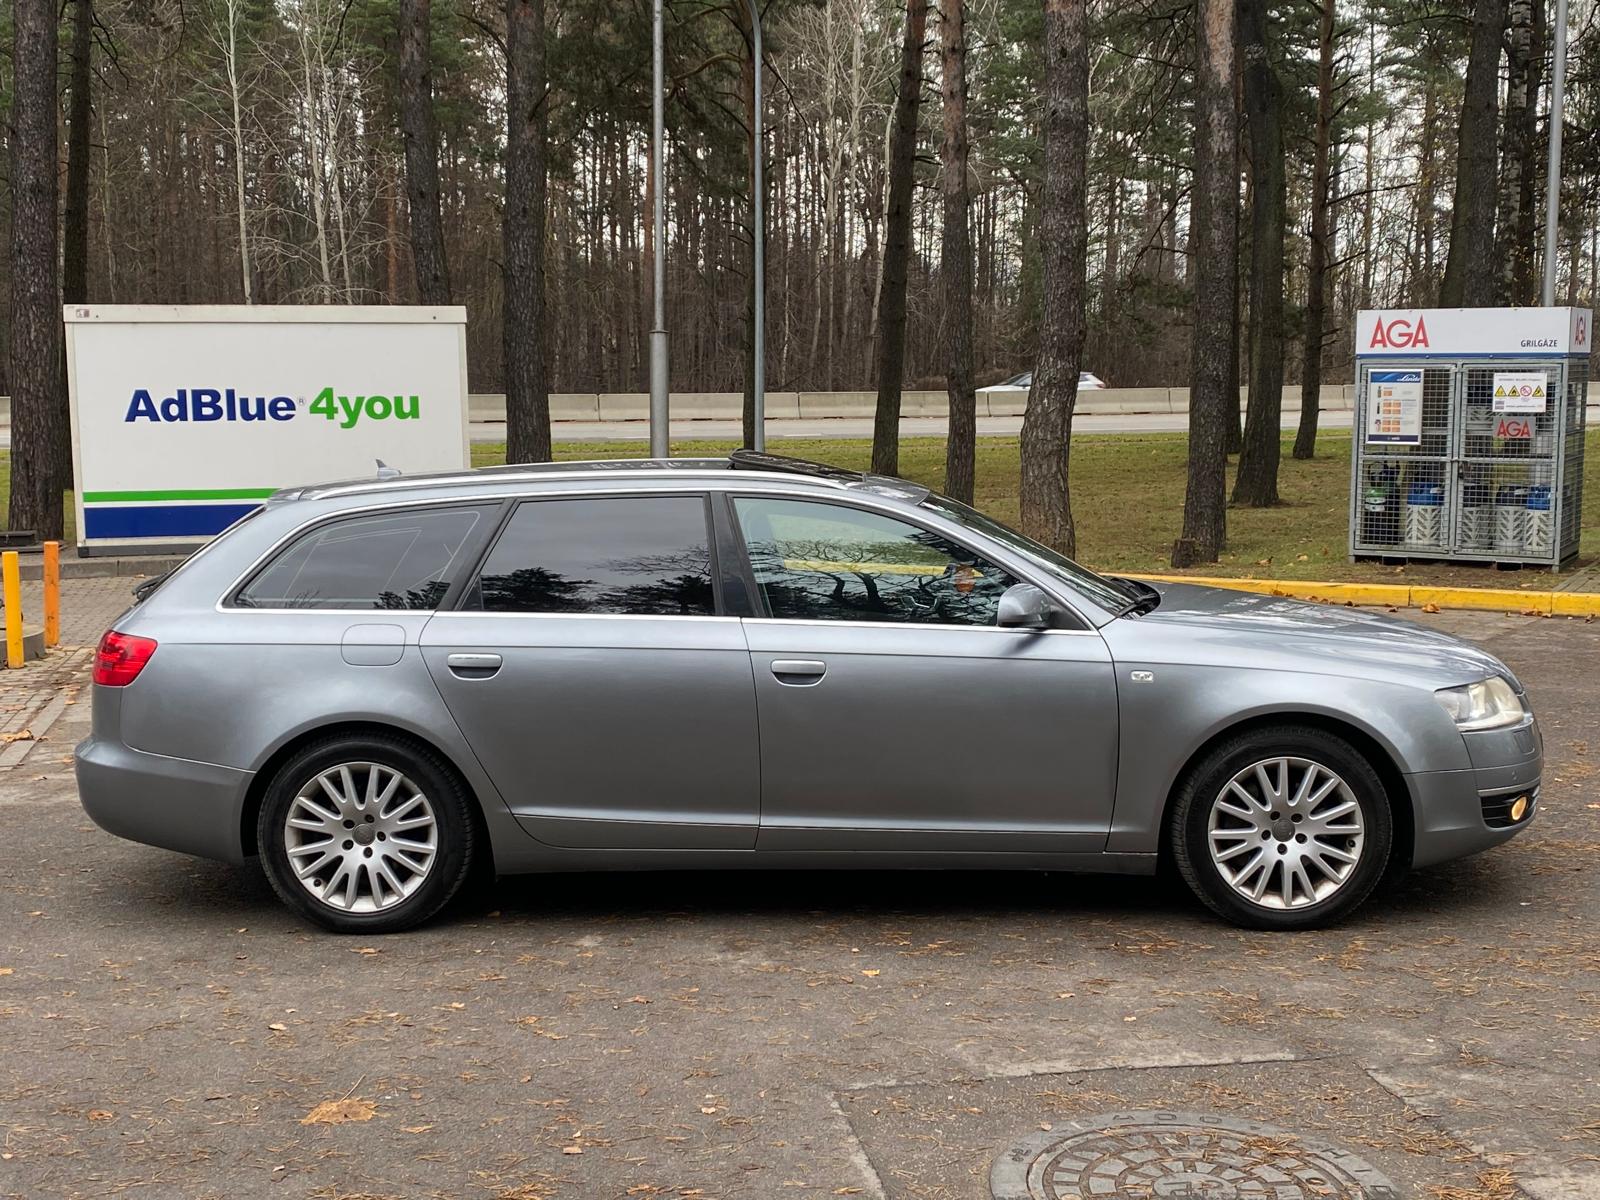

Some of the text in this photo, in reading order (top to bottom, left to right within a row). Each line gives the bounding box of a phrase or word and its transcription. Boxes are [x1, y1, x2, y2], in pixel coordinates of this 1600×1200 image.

[1370, 314, 1430, 349] AGA
[124, 387, 420, 429] AdBlue 4you
[1497, 417, 1531, 438] AGA
